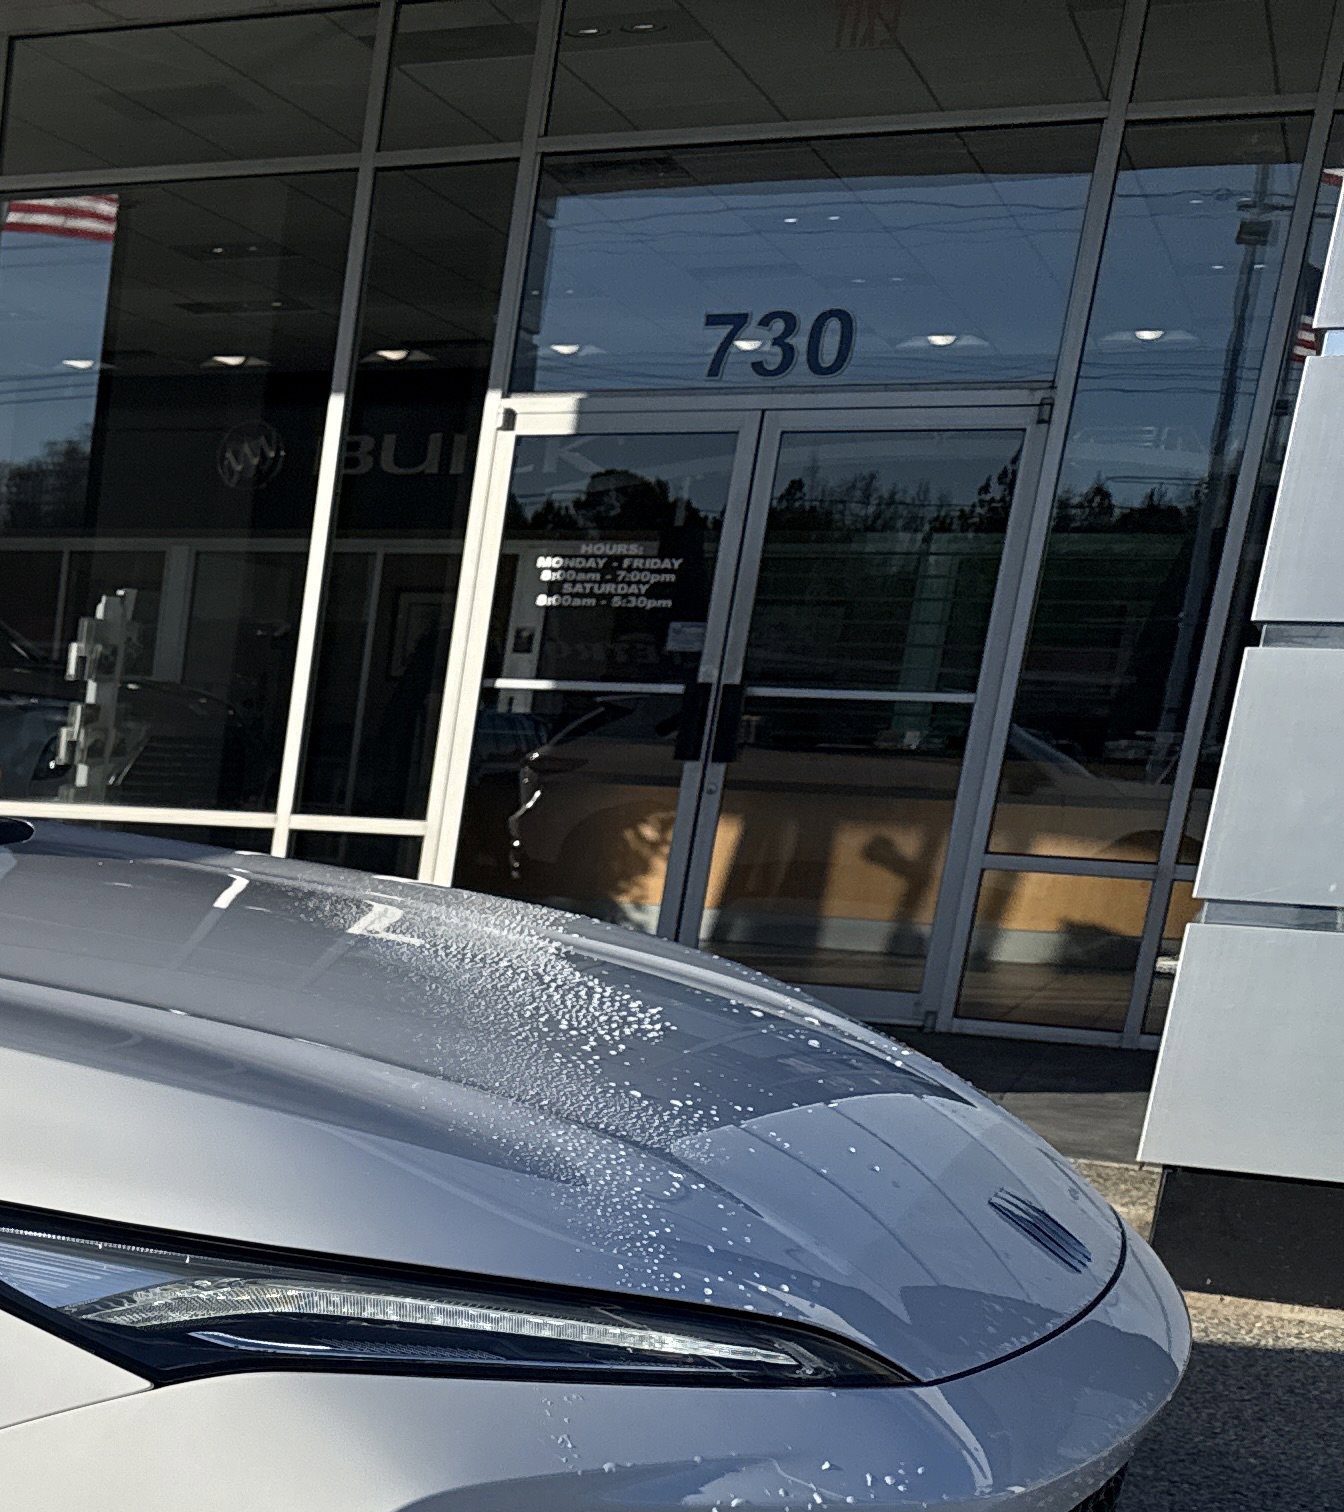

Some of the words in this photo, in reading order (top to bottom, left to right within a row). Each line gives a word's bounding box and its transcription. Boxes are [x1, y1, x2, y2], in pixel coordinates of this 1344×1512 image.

[703, 307, 858, 380] 730
[314, 432, 602, 475] BUIK
[580, 543, 644, 556] HOURS:
[536, 556, 608, 569] MONDAY
[622, 557, 684, 569] FRIDAY
[616, 570, 676, 583] 7:00pm
[562, 582, 650, 594] SATURDAY
[611, 595, 673, 609] 5:30pm
